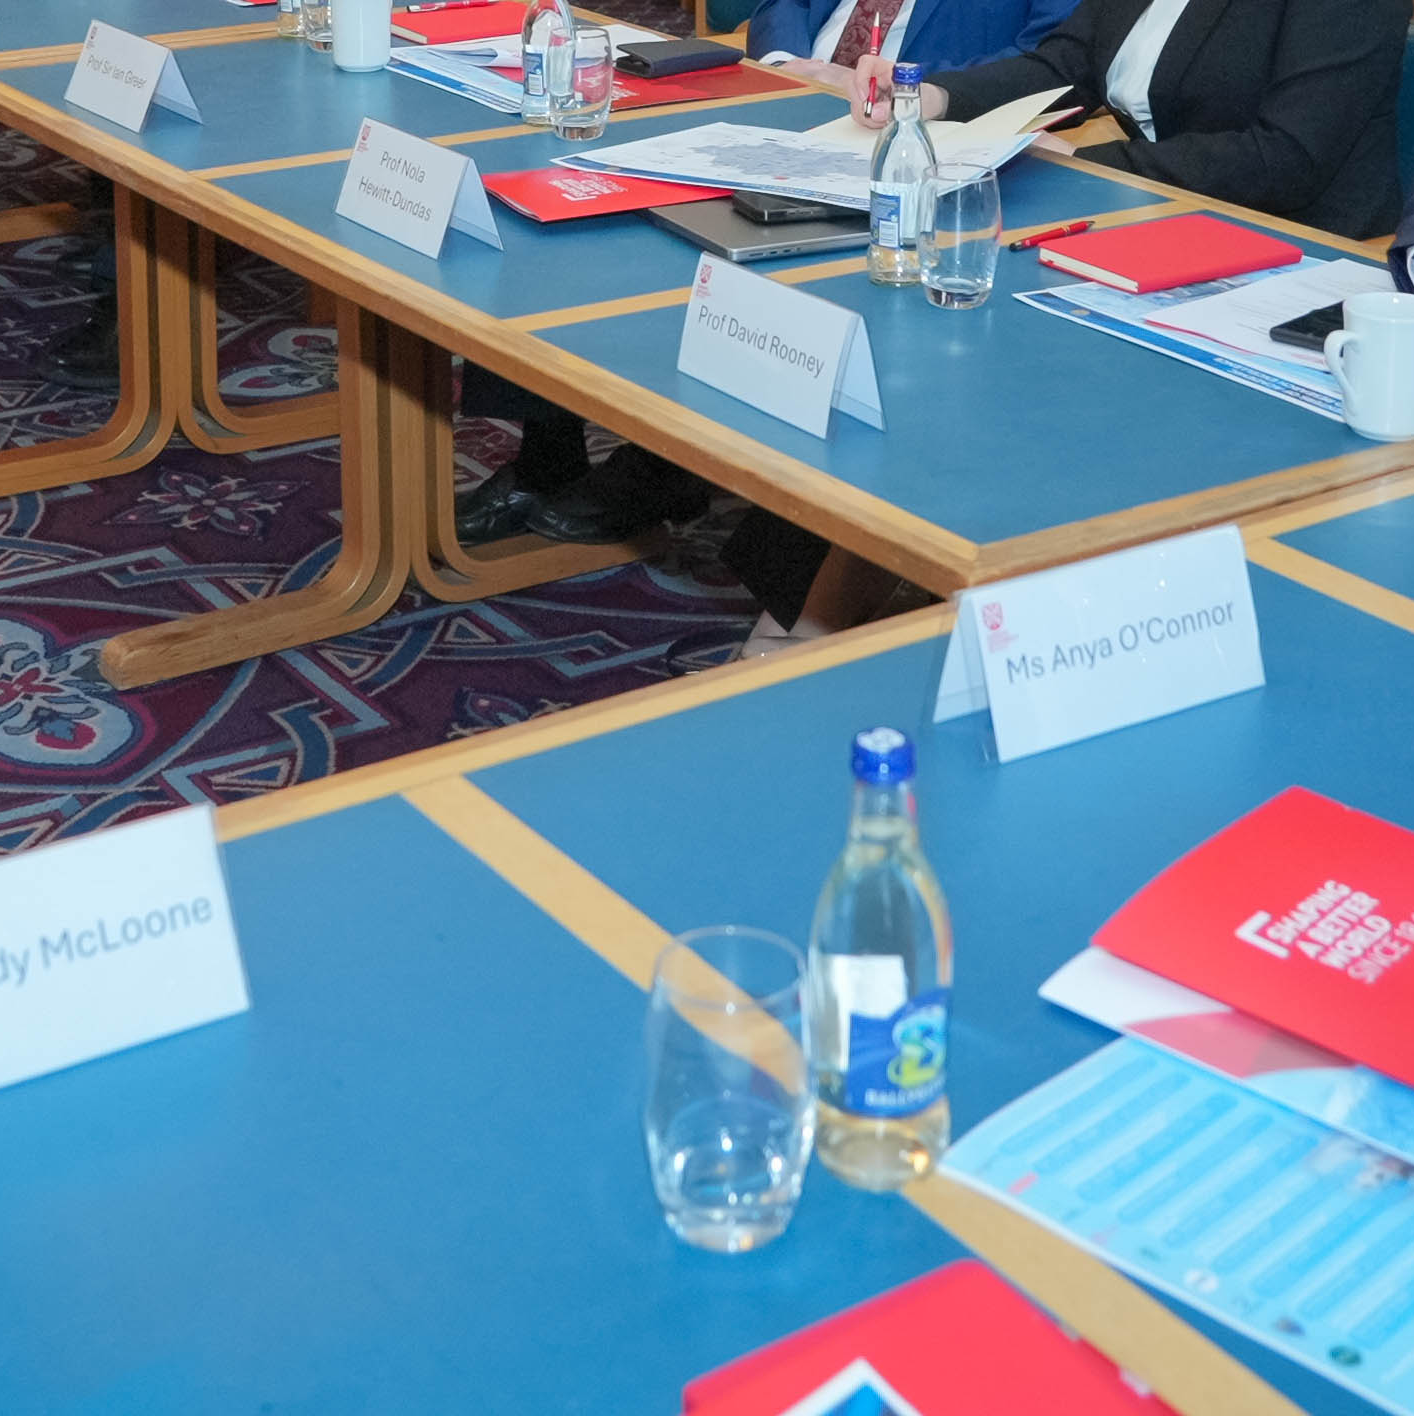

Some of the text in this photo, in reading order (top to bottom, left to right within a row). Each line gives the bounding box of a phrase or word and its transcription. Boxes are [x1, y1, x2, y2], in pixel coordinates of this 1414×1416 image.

[87, 54, 104, 72] Prof
[380, 151, 426, 184] Prof Nola
[358, 176, 432, 222] Hewitt-Dundas
[698, 305, 825, 379] Prof David Rooney
[1006, 653, 1044, 684] Ms
[1051, 637, 1113, 672] Anya
[1119, 601, 1235, 652] O'Connor
[39, 895, 213, 968] McLoone
[1266, 880, 1351, 944] SHAPING
[1295, 891, 1380, 960] A BETTER
[1318, 914, 1391, 970] WORLD
[1347, 935, 1411, 985] SINCE
